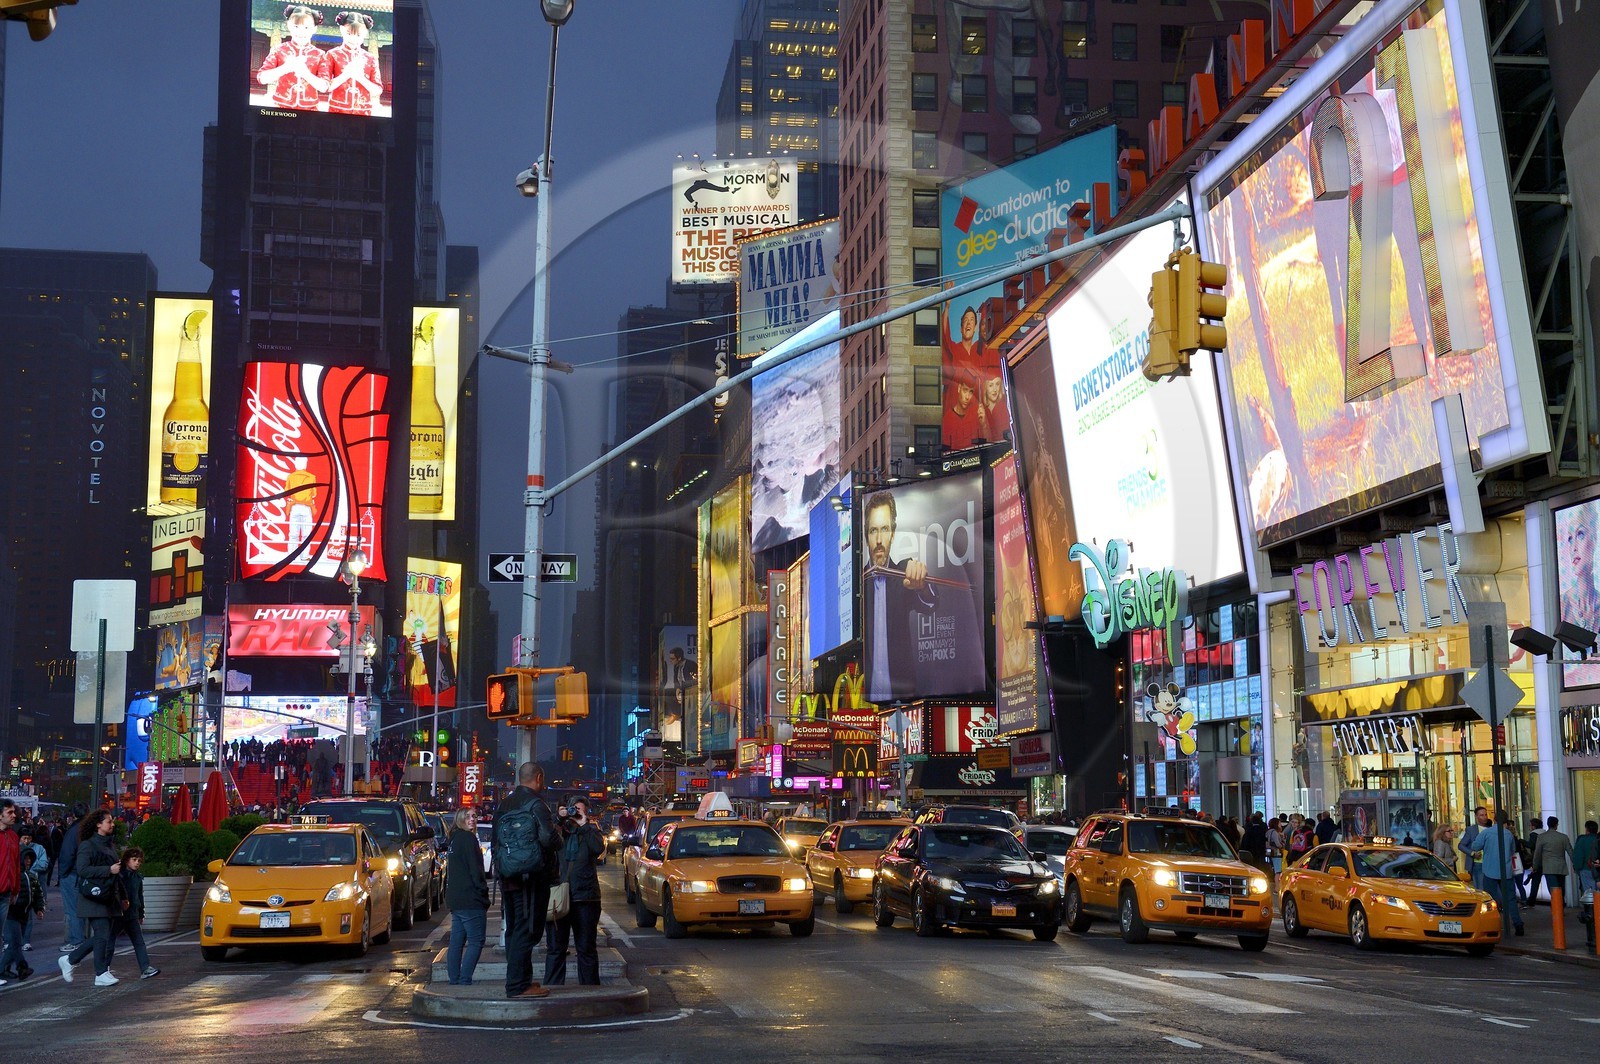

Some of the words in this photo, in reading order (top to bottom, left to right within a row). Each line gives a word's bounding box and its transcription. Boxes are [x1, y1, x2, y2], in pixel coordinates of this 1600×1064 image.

[682, 206, 718, 215] WINNER
[720, 205, 726, 214] 9
[728, 205, 752, 213] TONY
[752, 204, 790, 212] AWARDS
[973, 184, 1052, 225] Countdown
[1055, 178, 1071, 196] to
[682, 215, 719, 227] BEST
[723, 213, 790, 226] MUSICAL
[683, 261, 716, 274] THIS
[747, 238, 826, 292] MAMMA
[764, 281, 810, 330] MIA!
[1072, 330, 1152, 412] DISNEYSTORE.CO
[167, 421, 208, 435] Corona
[88, 387, 107, 504] NOVOTEL
[154, 517, 203, 540] INGLOT
[1291, 521, 1469, 653] FOREVER
[254, 607, 347, 621] HYUNDAI
[776, 582, 788, 704] PALACE
[918, 640, 935, 651] MON
[932, 648, 949, 661] FOX
[949, 648, 956, 660] 5
[832, 714, 880, 722] McDonald's
[792, 726, 832, 734] McDonald's
[1331, 716, 1408, 757] FOREVER
[1403, 715, 1426, 753] 21
[142, 764, 159, 793] tkts
[465, 765, 480, 793] tkts
[301, 816, 318, 825] 7A19
